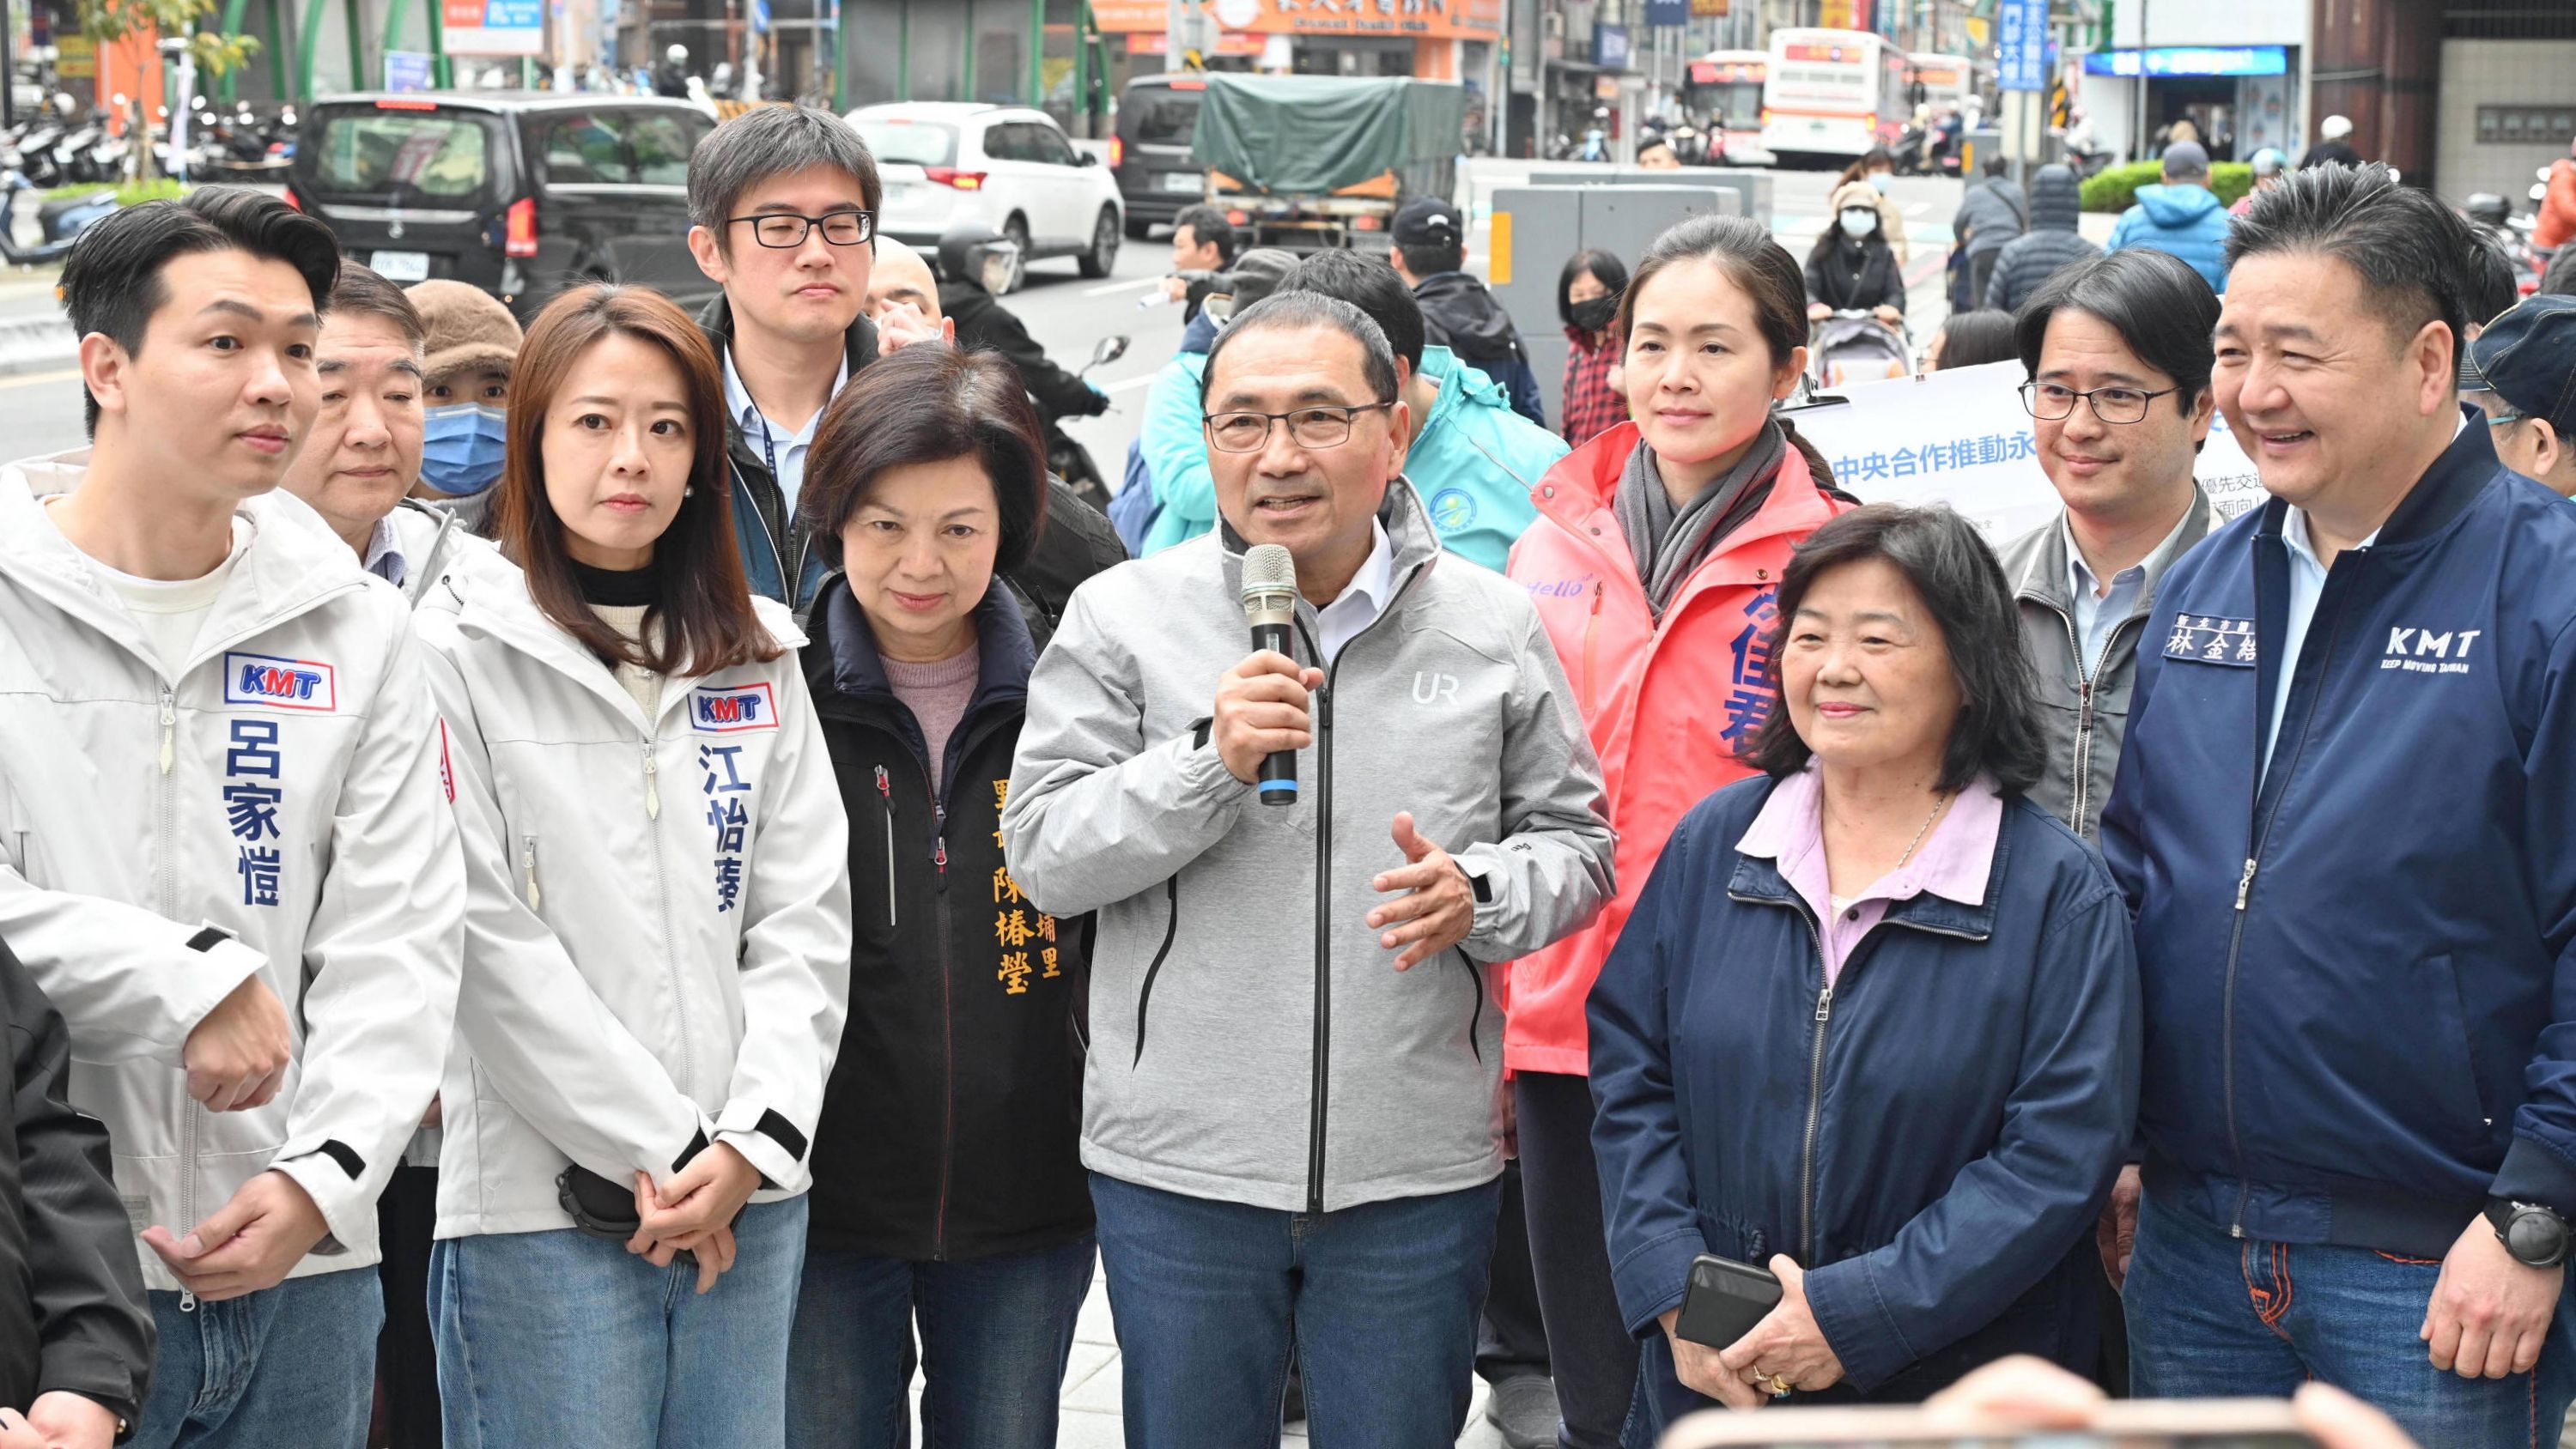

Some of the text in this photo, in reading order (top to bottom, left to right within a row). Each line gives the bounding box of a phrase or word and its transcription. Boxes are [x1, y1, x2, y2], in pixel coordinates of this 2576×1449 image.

[1525, 580, 1583, 598] Hello
[2385, 626, 2482, 658] KMT
[240, 664, 322, 700] KMT
[2379, 658, 2470, 674] KEEP MOVING TAIWAN
[1412, 670, 1461, 705] UR
[697, 694, 762, 723] KMT
[222, 718, 283, 906] 呂家愷
